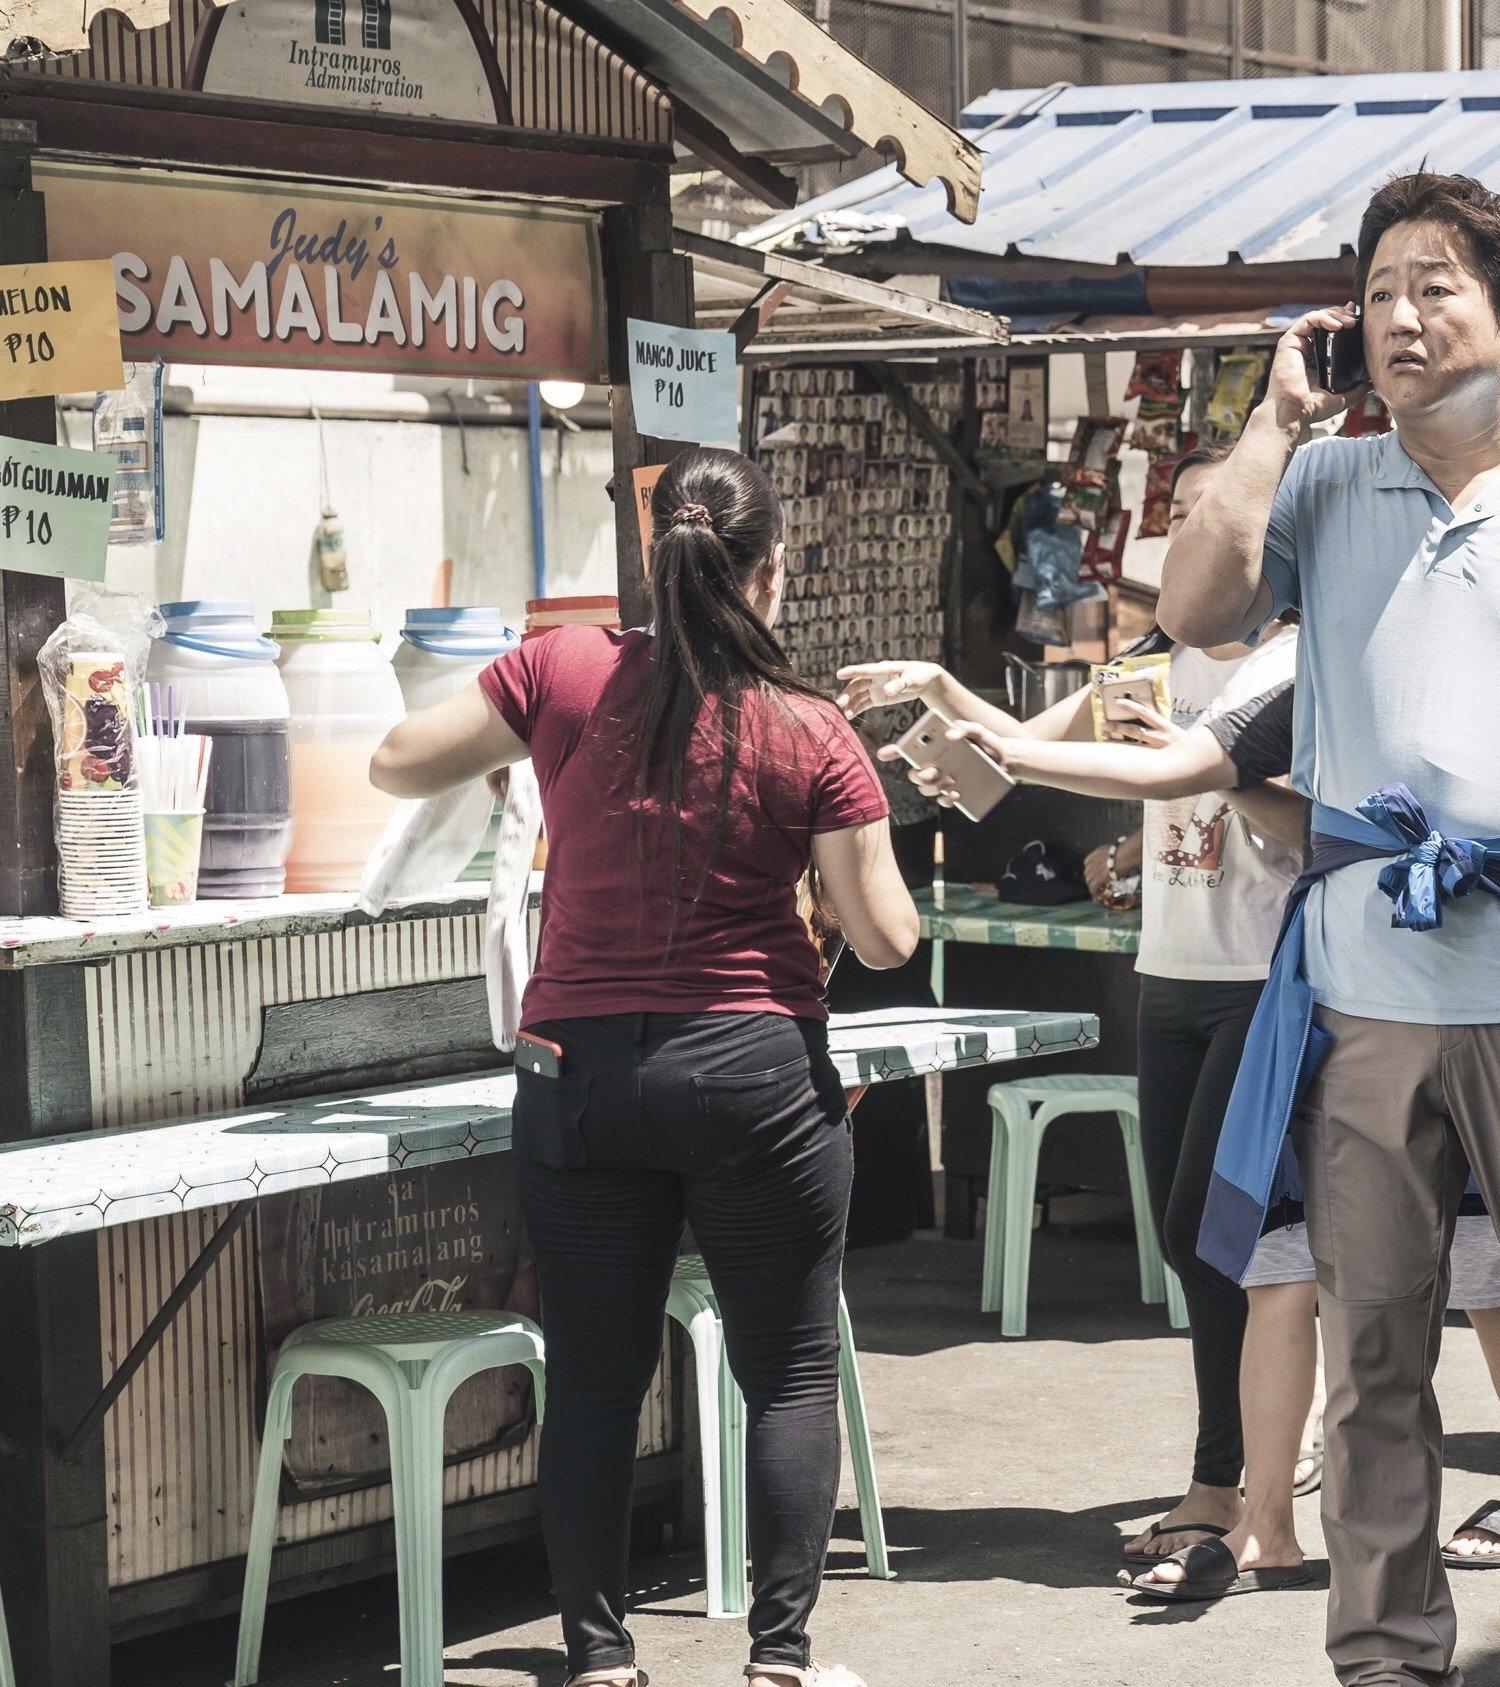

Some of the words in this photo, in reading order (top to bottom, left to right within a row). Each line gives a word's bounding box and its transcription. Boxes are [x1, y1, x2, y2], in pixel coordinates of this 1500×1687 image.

[288, 39, 402, 76] Intramuros
[304, 63, 424, 100] Administration
[265, 207, 400, 281] Judy's
[111, 250, 526, 353] SAMALAMIG
[635, 340, 674, 369] MANGO
[676, 347, 718, 373] JUICE
[21, 464, 110, 503] GULAMAN
[387, 1179, 414, 1202] sa
[321, 1201, 480, 1251] Intramuros
